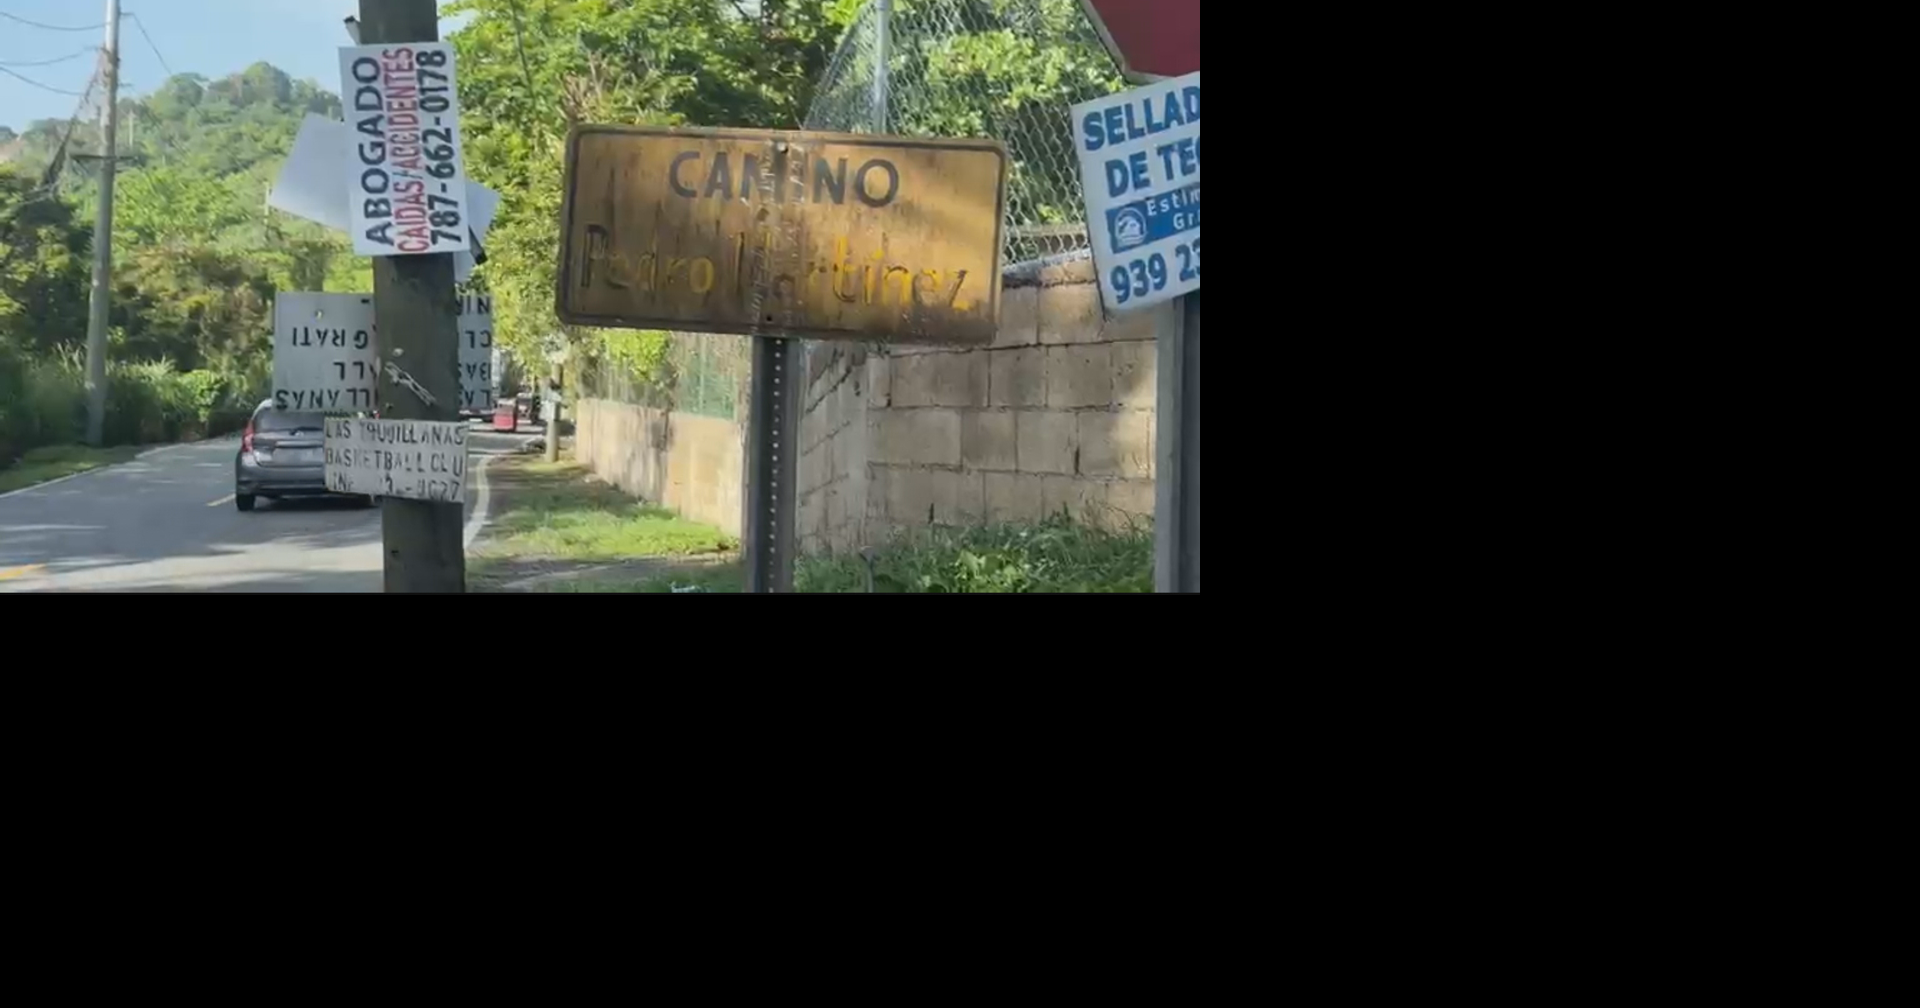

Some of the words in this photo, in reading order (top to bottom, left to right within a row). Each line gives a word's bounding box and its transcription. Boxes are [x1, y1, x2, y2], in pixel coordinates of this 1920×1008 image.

[352, 57, 394, 245] ABOGADO
[416, 50, 461, 245] 787-662-0178
[669, 151, 899, 208] CAMINO
[1105, 151, 1150, 198] DE
[1157, 136, 1200, 181] TE
[581, 223, 715, 298] Pedro
[1110, 252, 1168, 304] 939
